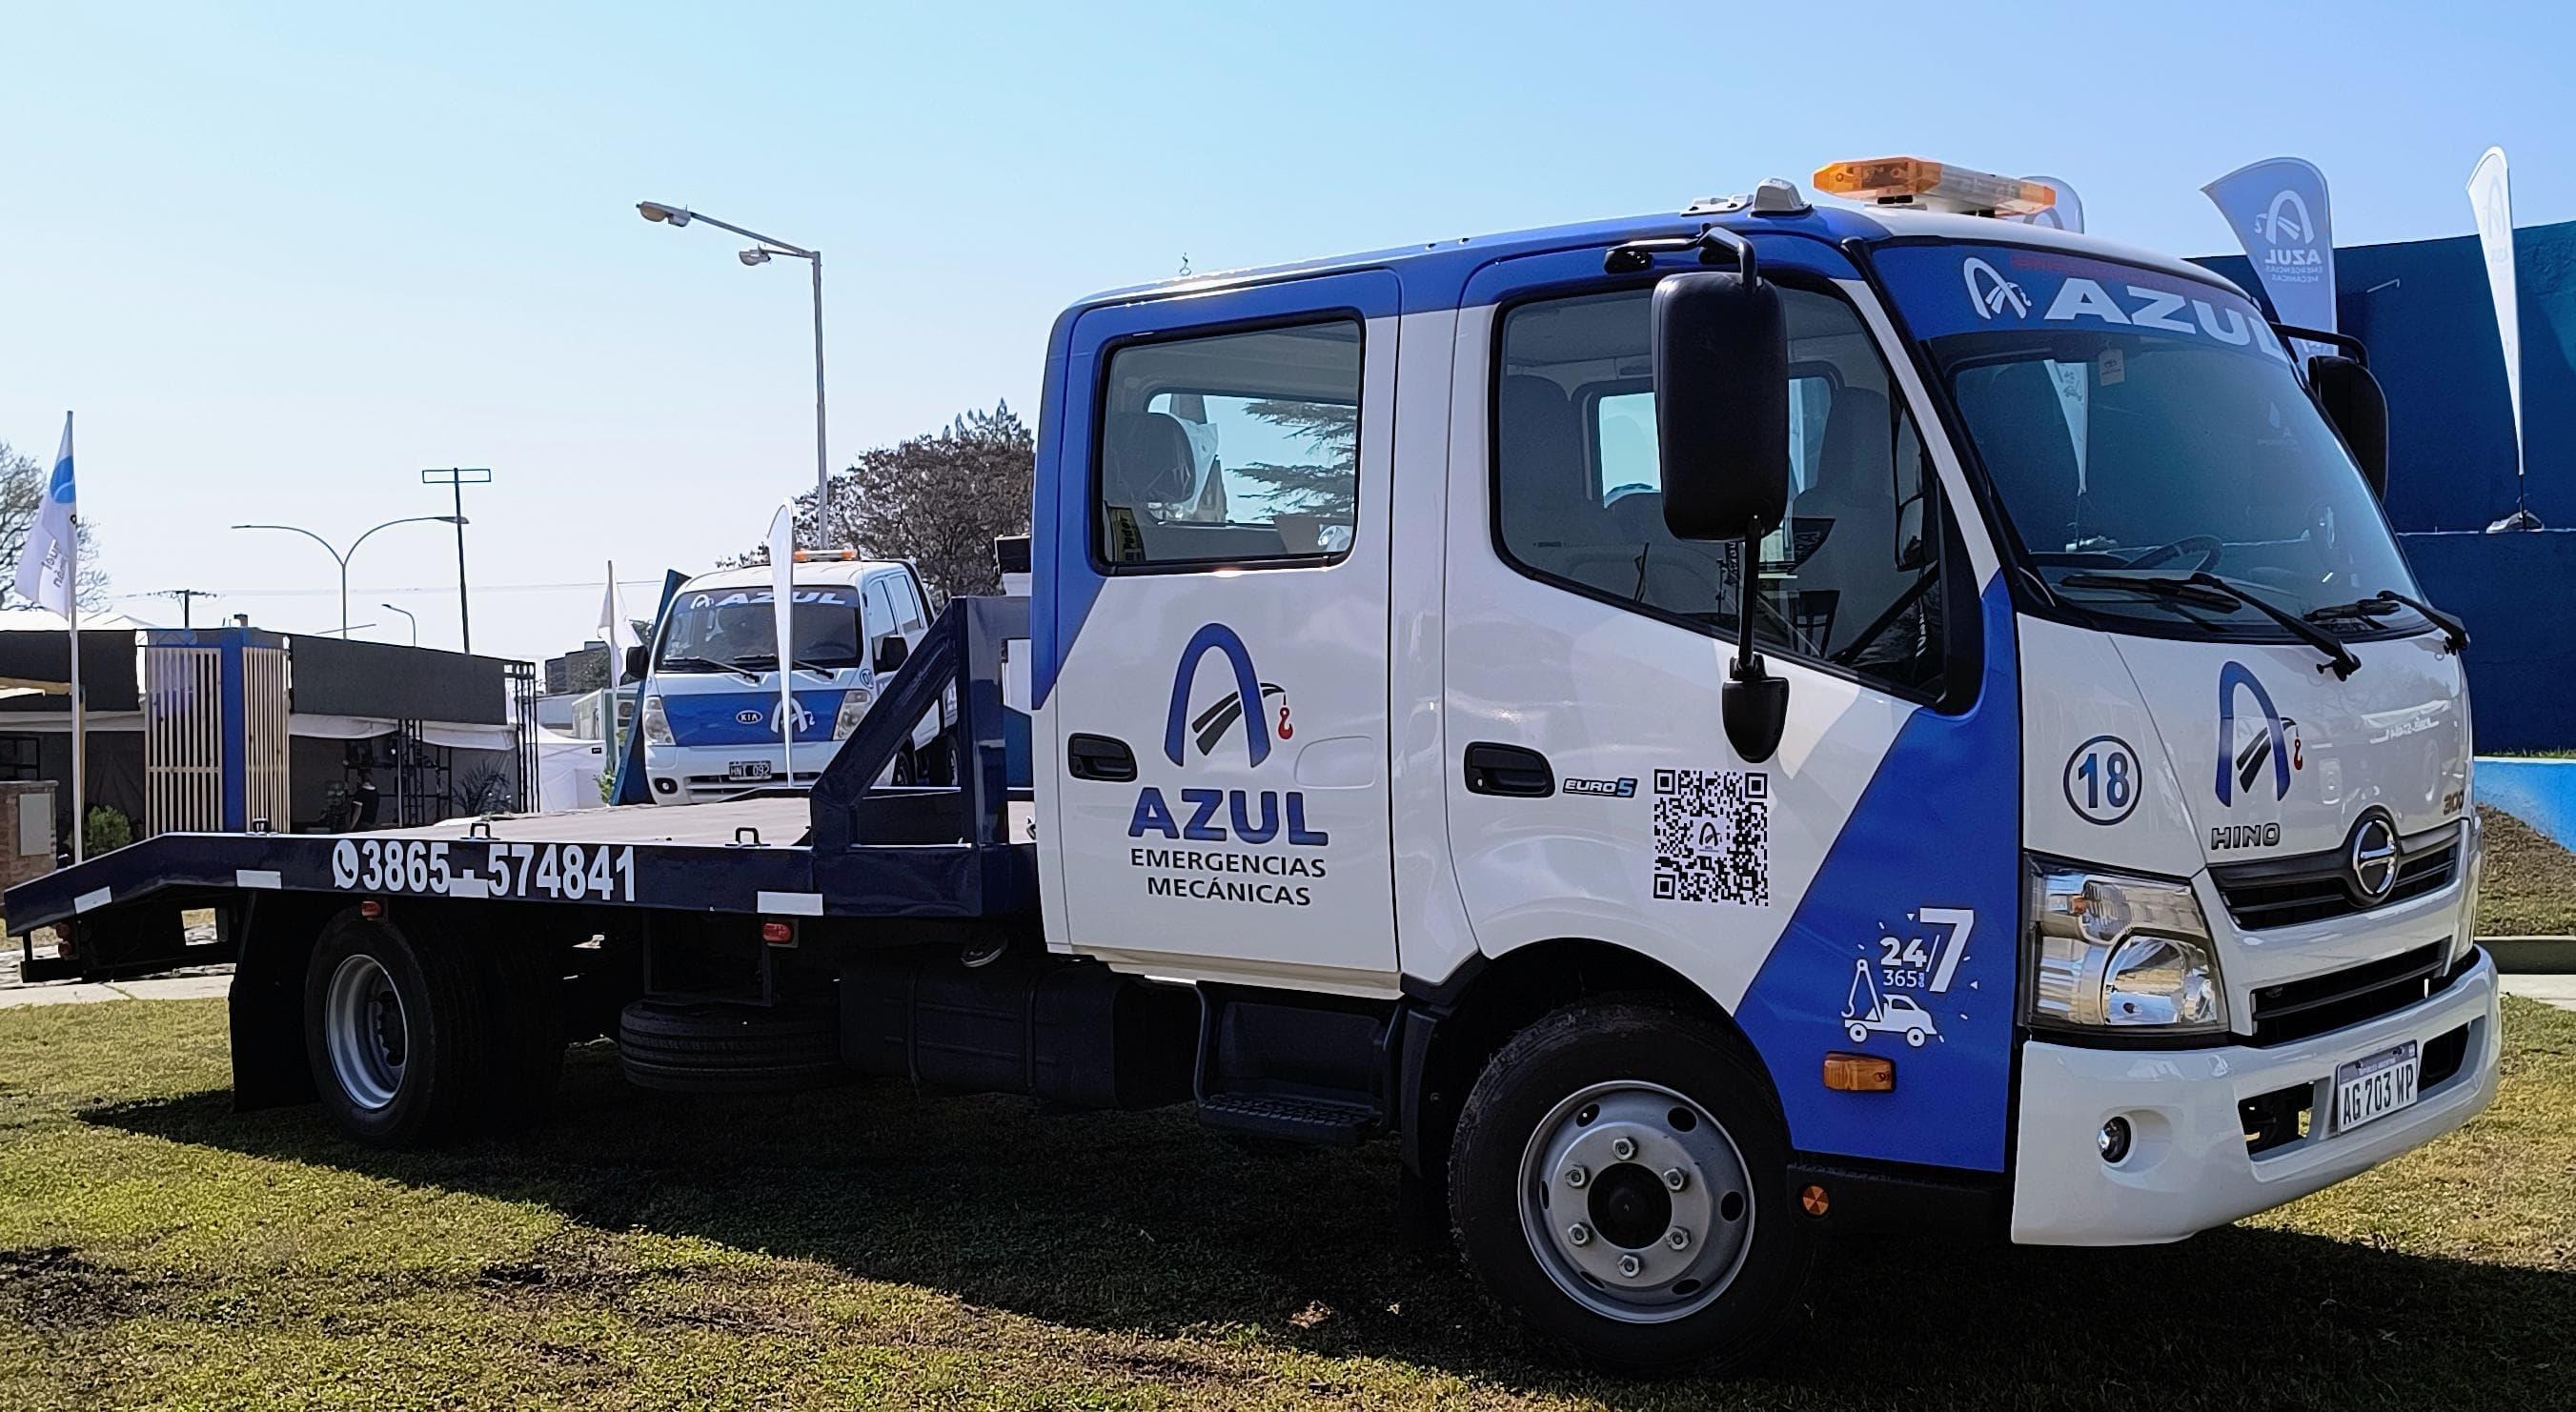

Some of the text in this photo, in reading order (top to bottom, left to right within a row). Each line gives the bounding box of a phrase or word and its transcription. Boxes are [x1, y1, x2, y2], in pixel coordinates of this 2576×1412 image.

[2043, 277, 2288, 365] AZUL
[753, 764, 770, 777] 092
[2078, 752, 2130, 809] 18
[1128, 787, 1329, 846] AZUL
[2211, 823, 2281, 850] HINO
[362, 840, 451, 894] 3865
[487, 843, 635, 901] 574841
[1130, 848, 1327, 878] EMERGENCIAS
[1147, 877, 1311, 906] MECÁNICAS
[1882, 969, 1917, 988] 365
[2343, 1082, 2362, 1125] AG
[2364, 1071, 2392, 1116] 703
[2396, 1063, 2414, 1105] WP
